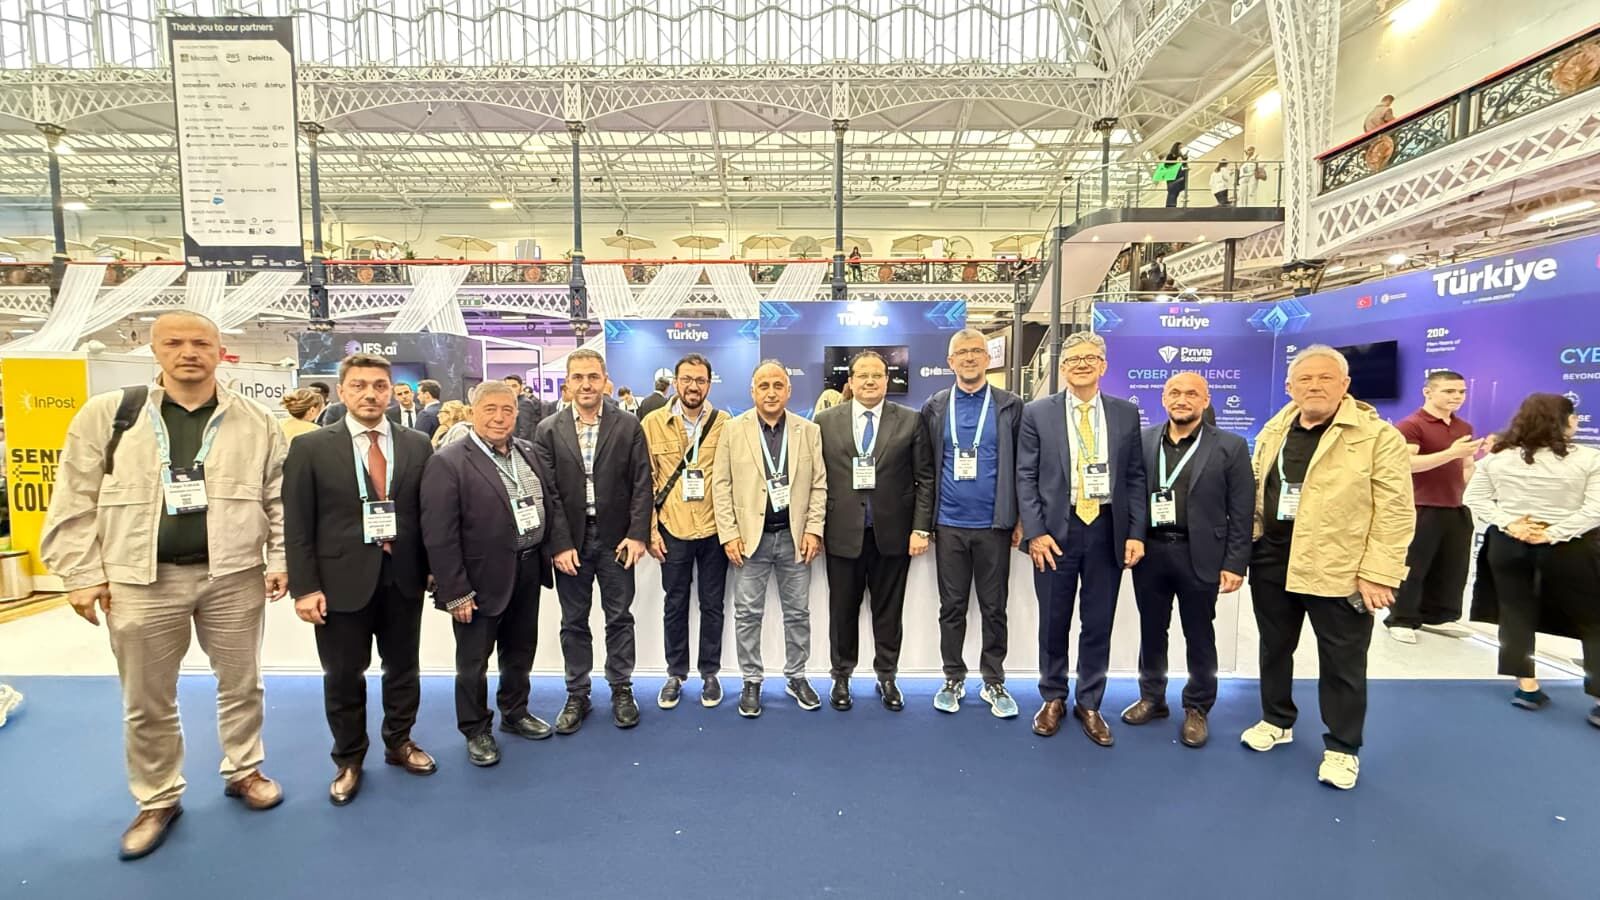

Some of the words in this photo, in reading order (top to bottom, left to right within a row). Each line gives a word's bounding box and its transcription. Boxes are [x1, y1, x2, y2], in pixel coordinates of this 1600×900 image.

[172, 22, 197, 32] Thank
[197, 24, 213, 33] you
[214, 23, 224, 32] to
[224, 24, 238, 32] our
[240, 23, 274, 33] partners
[1432, 257, 1558, 297] Türkiye
[1159, 315, 1210, 329] Türkiye
[666, 328, 709, 342] Türkiye
[1426, 327, 1449, 338] 200+
[362, 341, 398, 356] IFS.ai
[1180, 346, 1213, 356] Privia
[1180, 356, 1212, 364] Security
[1127, 369, 1168, 379] CYBER
[240, 382, 287, 398] InPost
[34, 396, 76, 409] InPost
